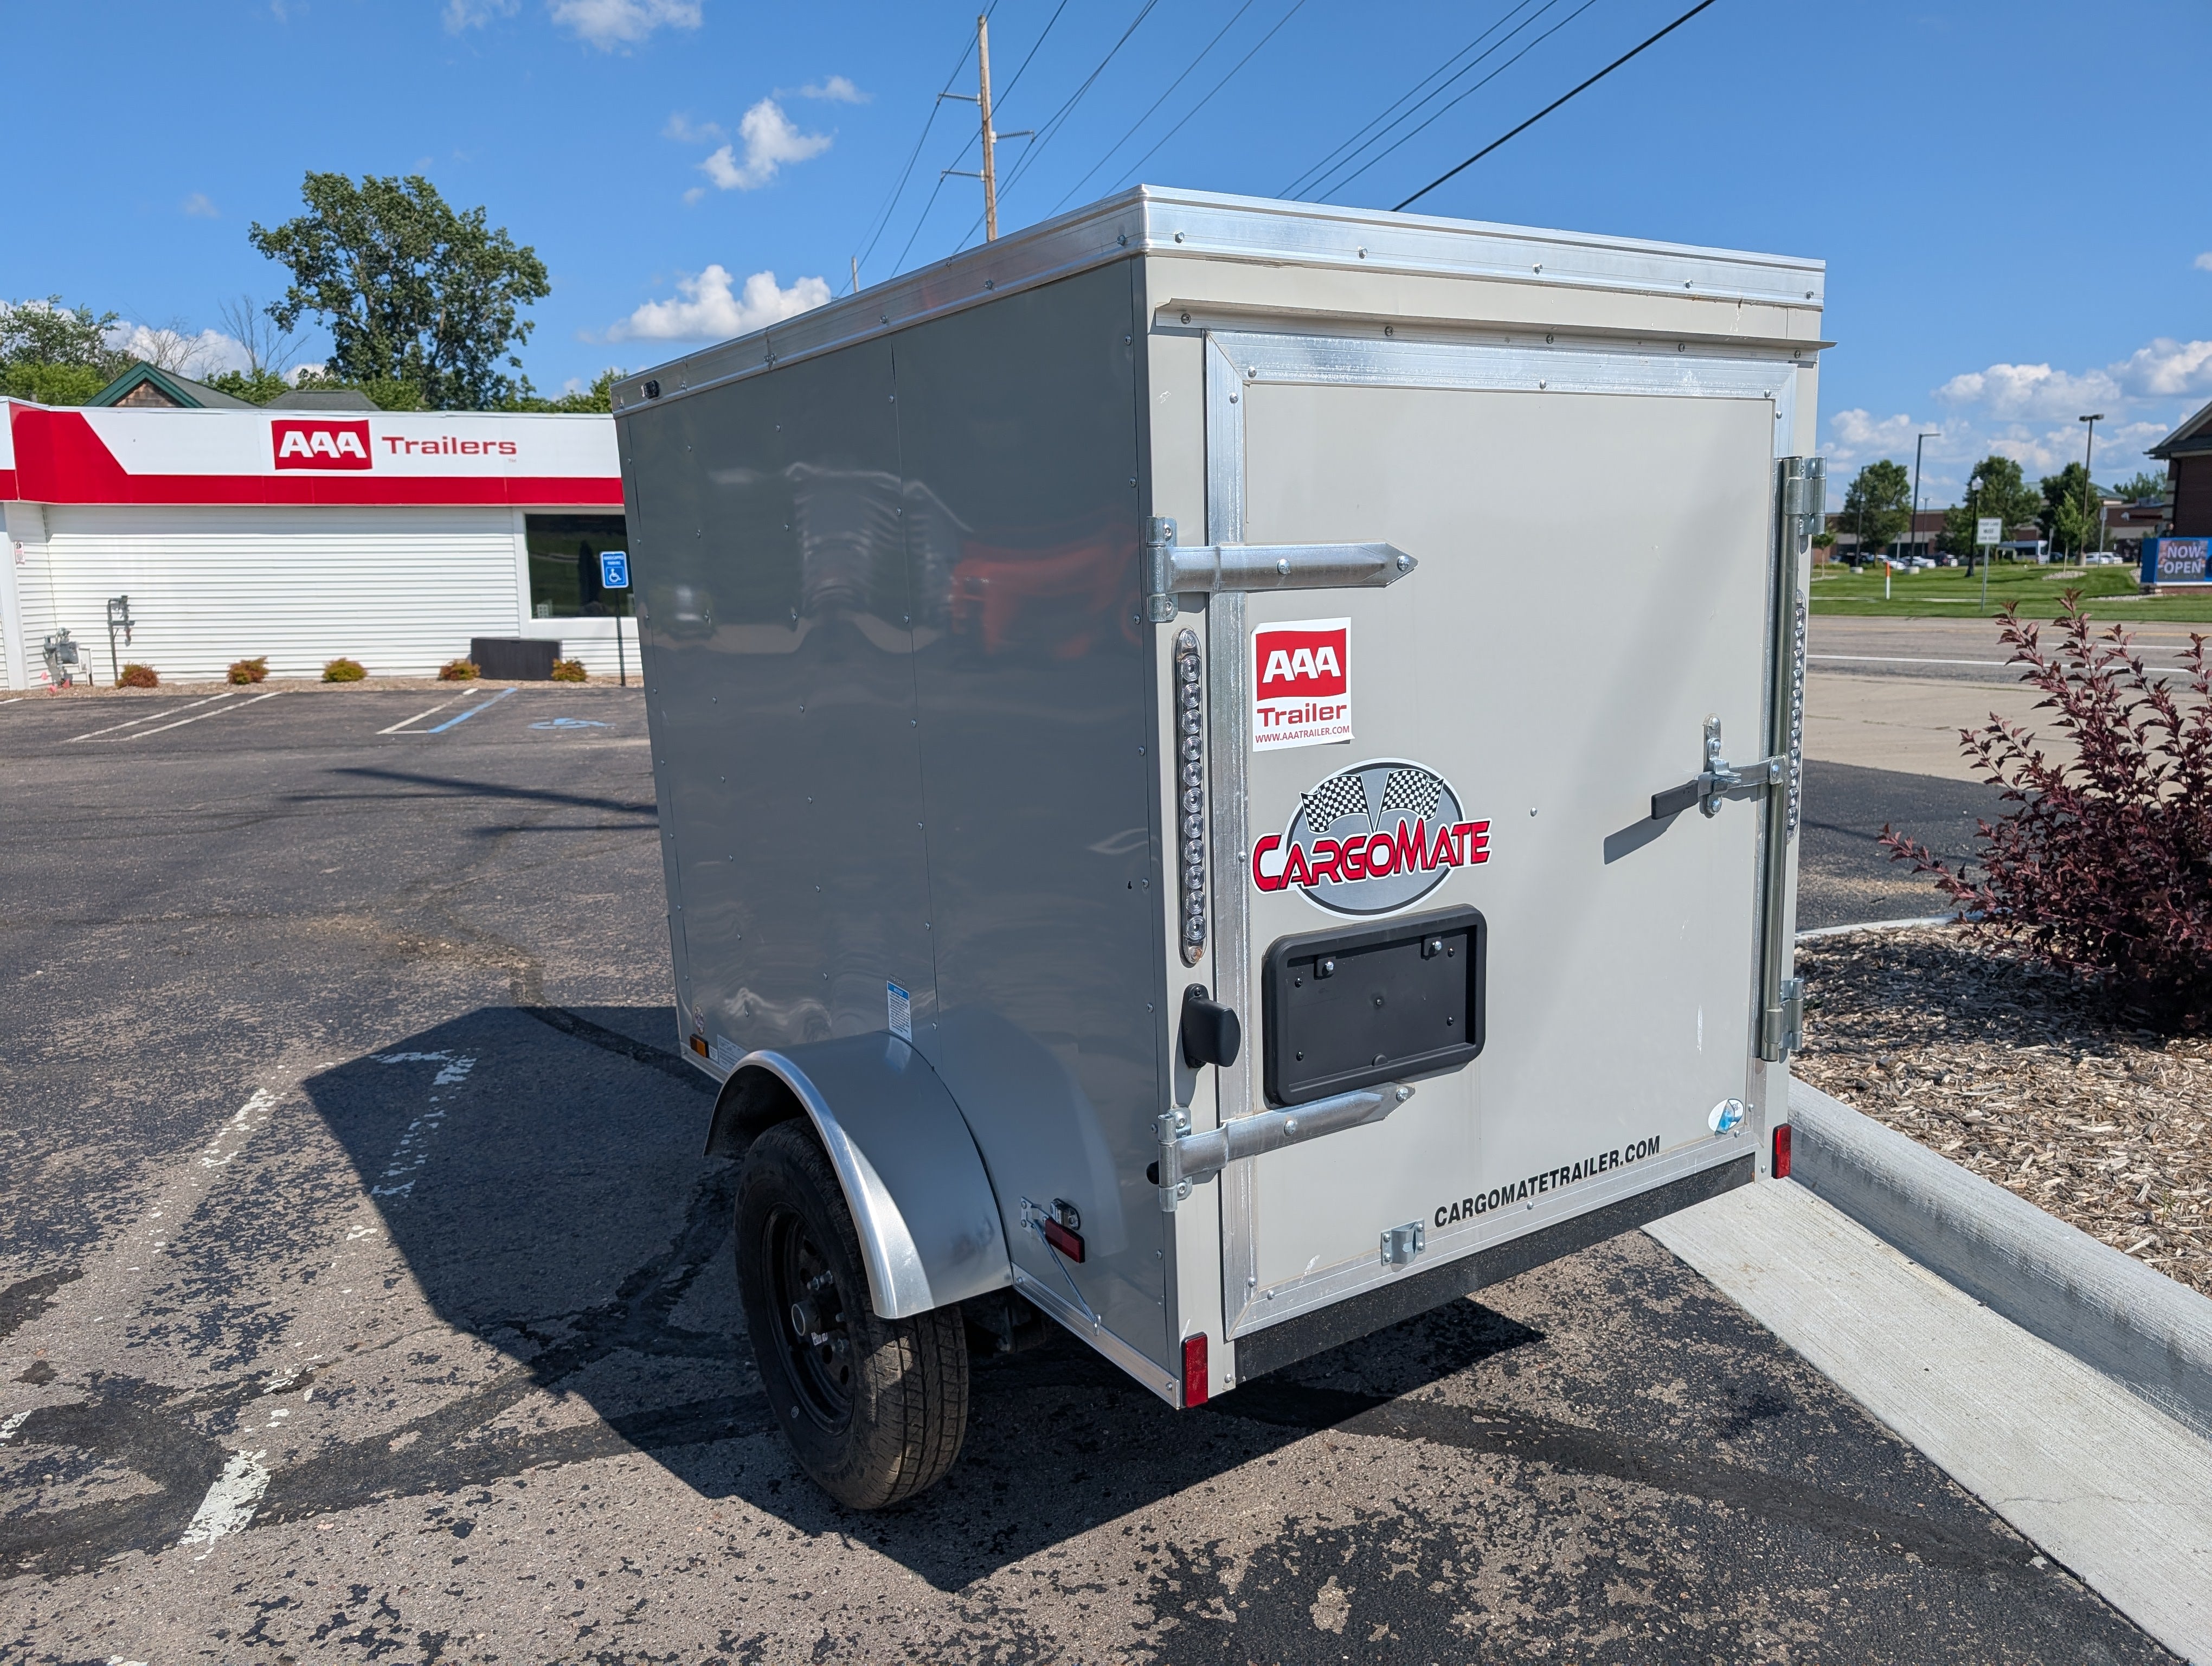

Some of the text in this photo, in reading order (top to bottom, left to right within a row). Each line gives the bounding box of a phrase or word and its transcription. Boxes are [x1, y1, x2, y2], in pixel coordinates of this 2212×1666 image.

[279, 431, 517, 458] AAA Trailers
[2168, 545, 2201, 559] NOW
[2164, 561, 2201, 574] OPEN
[1262, 646, 1341, 683] AAA
[1257, 702, 1347, 727] Trailer
[1255, 725, 1350, 744] WWW.AAATRAILER.COM
[1252, 817, 1490, 892] CARGOMATE
[1435, 1135, 1660, 1228] CARGOMATETRAILER.COM
